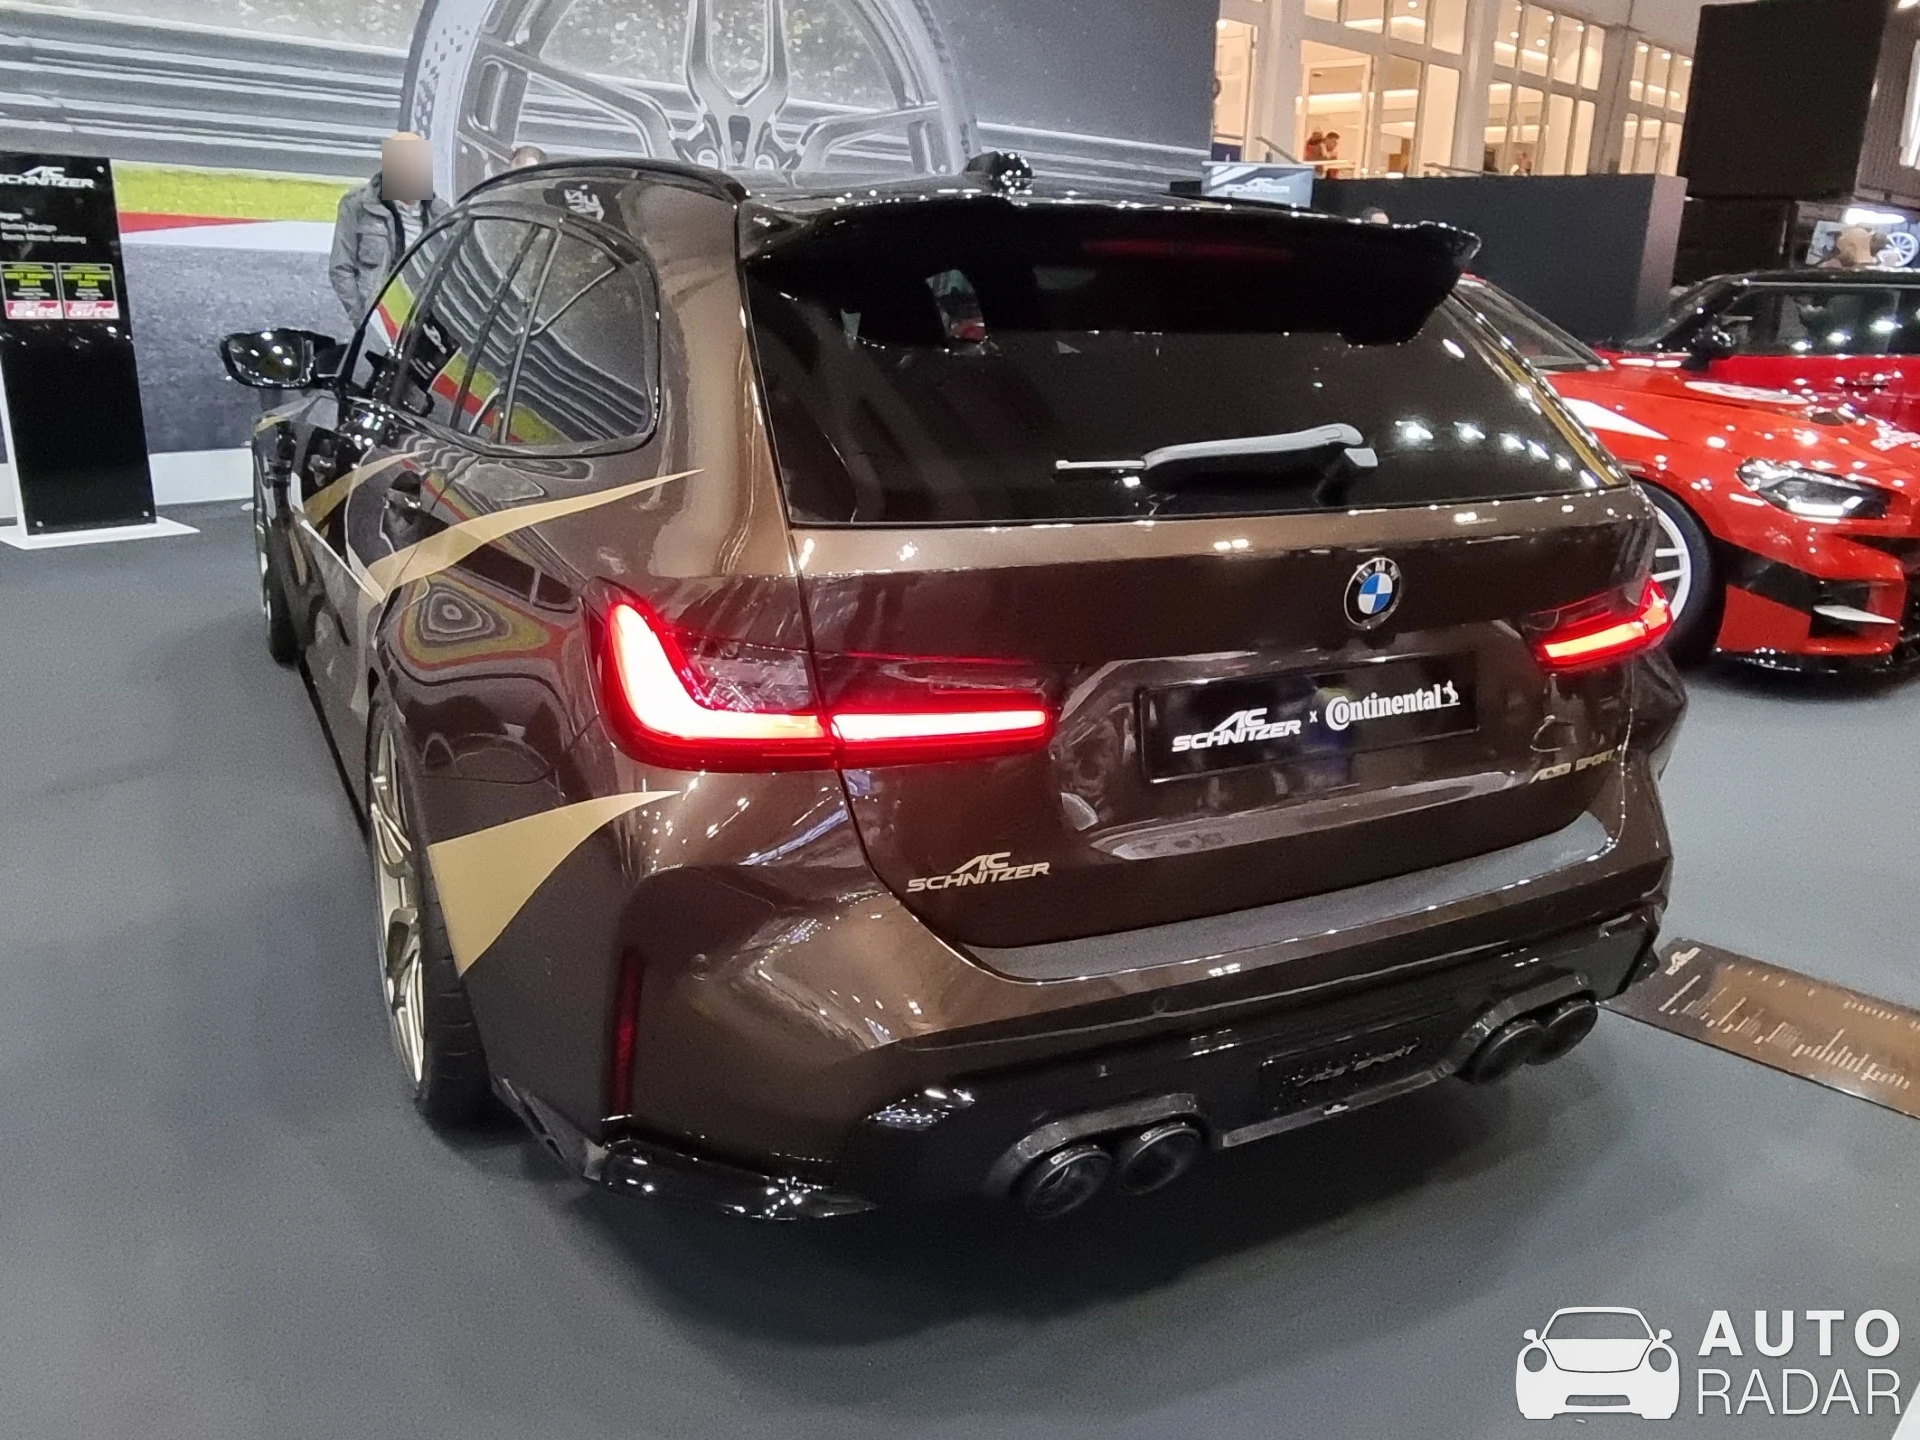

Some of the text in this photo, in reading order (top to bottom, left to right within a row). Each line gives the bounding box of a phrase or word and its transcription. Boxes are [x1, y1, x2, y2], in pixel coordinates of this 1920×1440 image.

[1355, 559, 1399, 584] BMW
[1172, 719, 1301, 752] SCHNITZER
[1326, 683, 1442, 731] Continental
[1213, 707, 1268, 733] AC
[951, 851, 1011, 875] AC
[906, 861, 1051, 893] SCHNITZER
